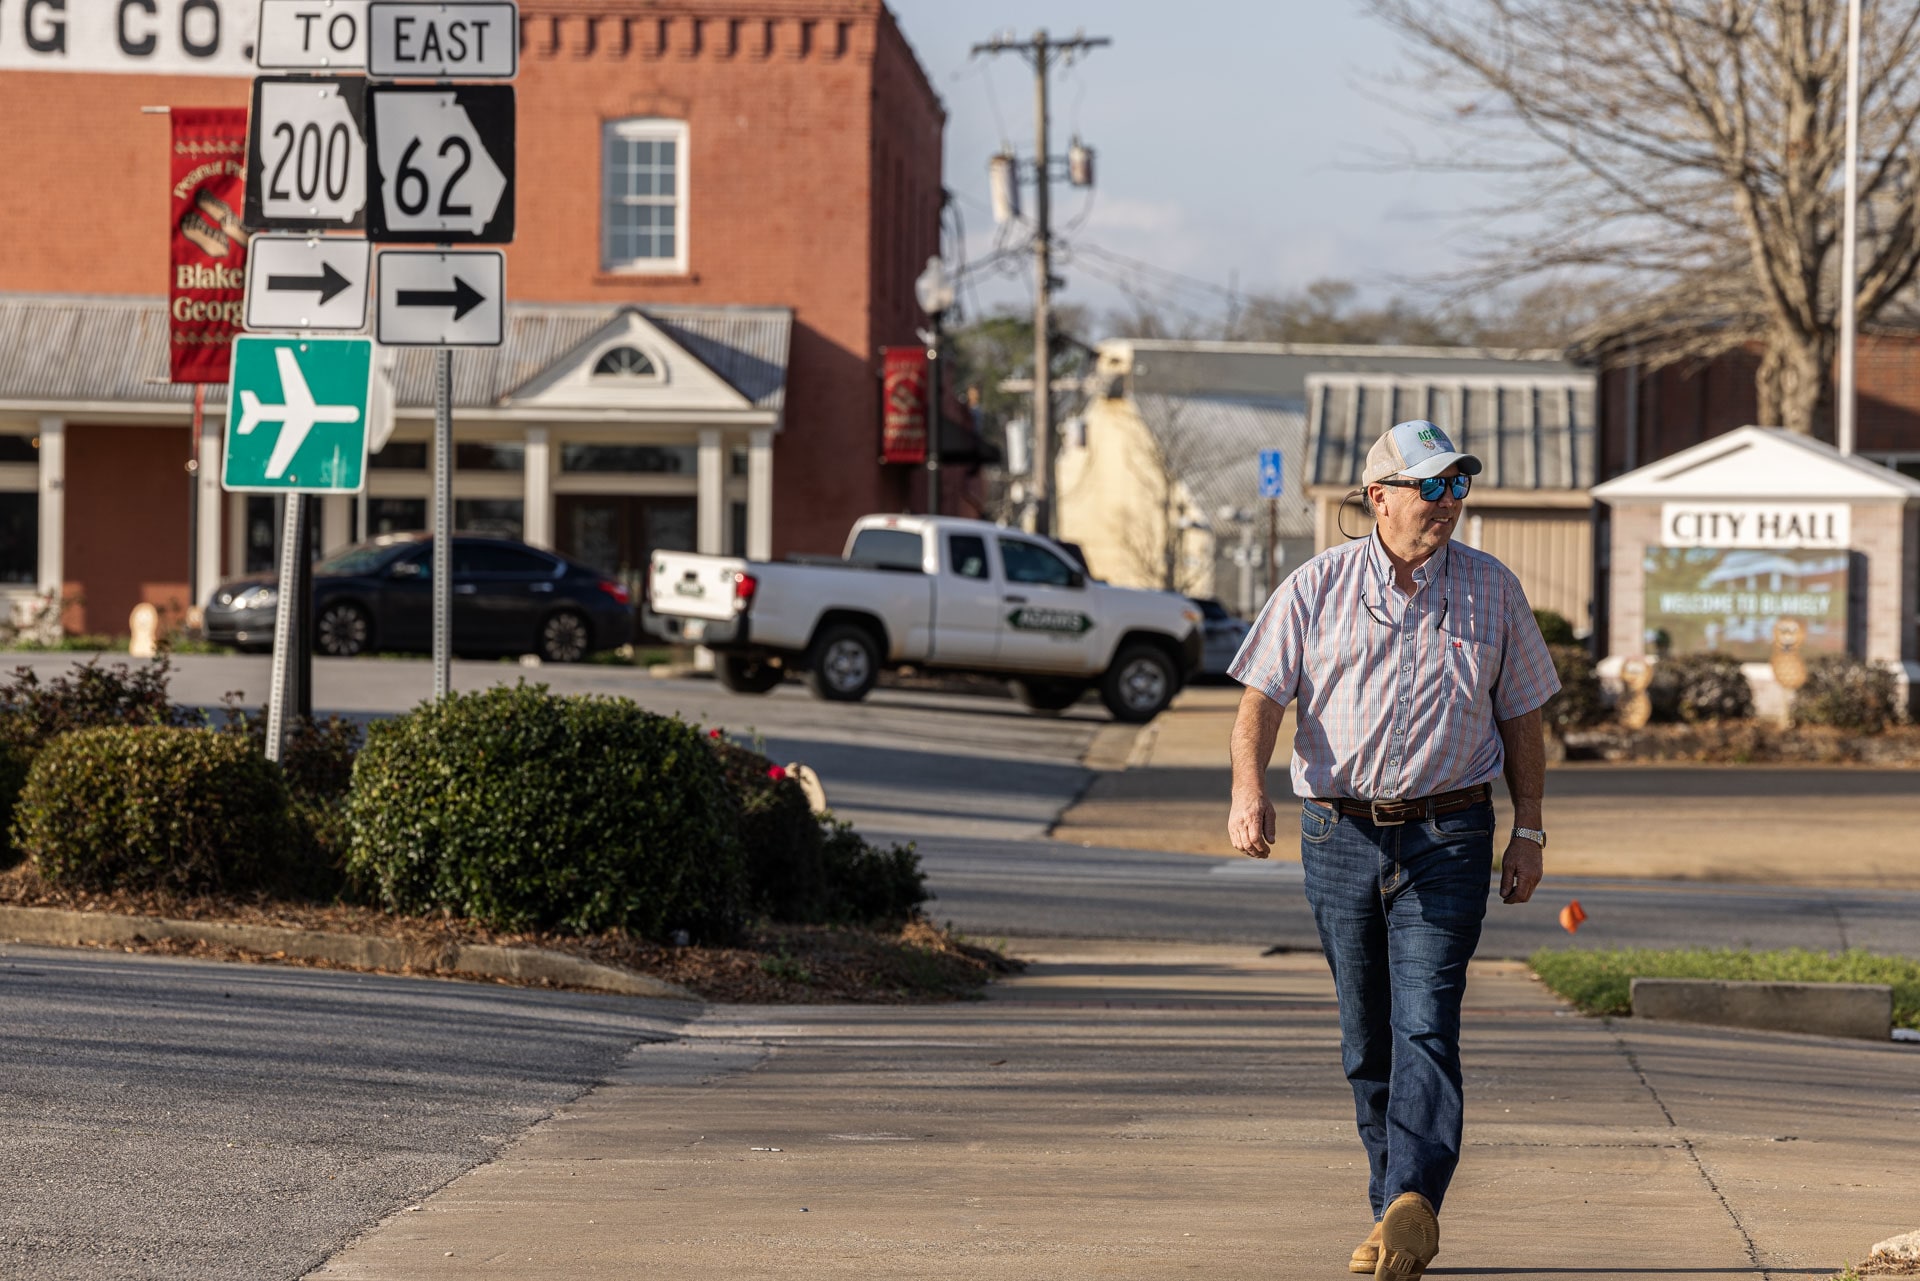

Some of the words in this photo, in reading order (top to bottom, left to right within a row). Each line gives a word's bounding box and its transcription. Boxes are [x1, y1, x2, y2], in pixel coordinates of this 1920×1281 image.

[296, 14, 357, 51] TO
[394, 17, 490, 62] EAST
[173, 160, 223, 200] Peanut
[269, 121, 351, 201] 200
[395, 136, 472, 216] 62
[1671, 511, 1746, 540] CITY
[1757, 512, 1838, 541] HALL
[1659, 592, 1734, 614] WELCOME
[1736, 592, 1758, 614] TO
[1760, 593, 1832, 616] BLAKELY
